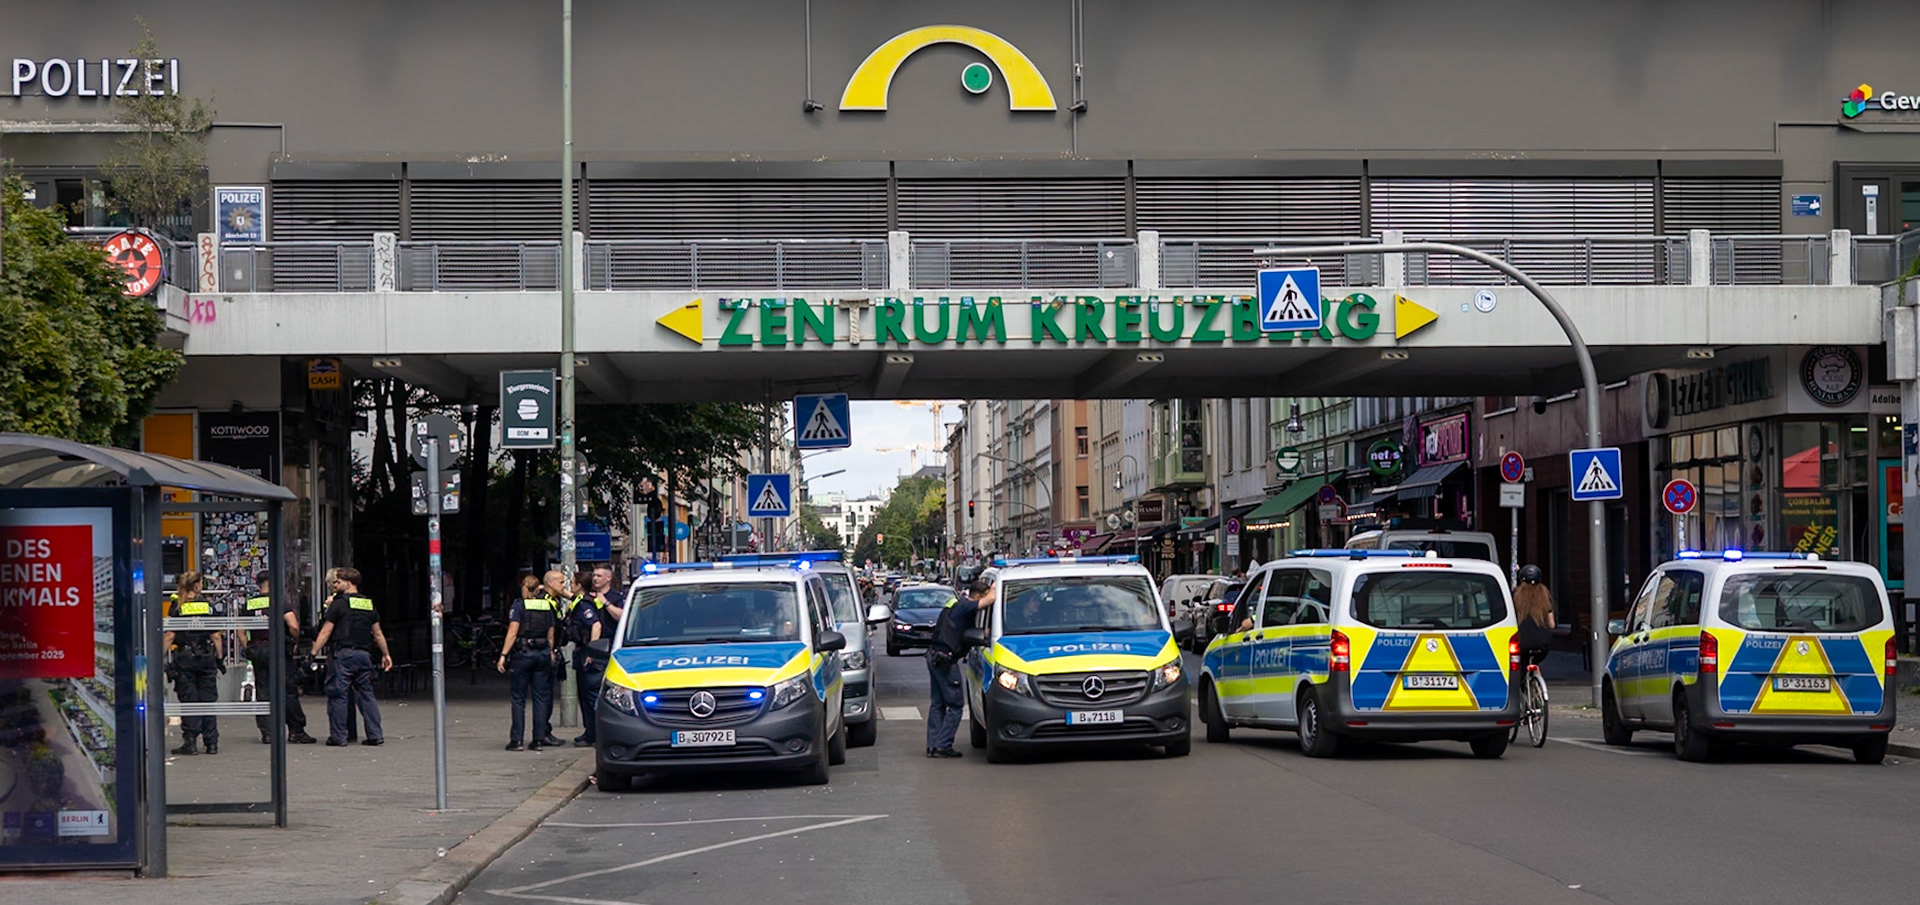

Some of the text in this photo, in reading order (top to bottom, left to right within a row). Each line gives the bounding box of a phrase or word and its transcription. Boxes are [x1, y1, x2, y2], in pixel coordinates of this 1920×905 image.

[13, 58, 179, 96] POLIZEI
[221, 193, 259, 203] POLIZEI
[719, 296, 1007, 346] ZENTRUM
[211, 426, 269, 434] KOTTIWOOD
[7, 538, 51, 558] DES
[1048, 643, 1131, 654] POLIZEI
[1377, 639, 1412, 648] POLIZEI
[1746, 640, 1782, 650] POLIZEI
[40, 650, 65, 660] 2025
[1254, 647, 1287, 668] POLIZEI
[657, 656, 748, 668] POLIZEI
[1412, 676, 1454, 686] B 31174
[1782, 678, 1826, 688] B 31163
[1080, 712, 1116, 722] B 7118
[679, 733, 686, 742] B
